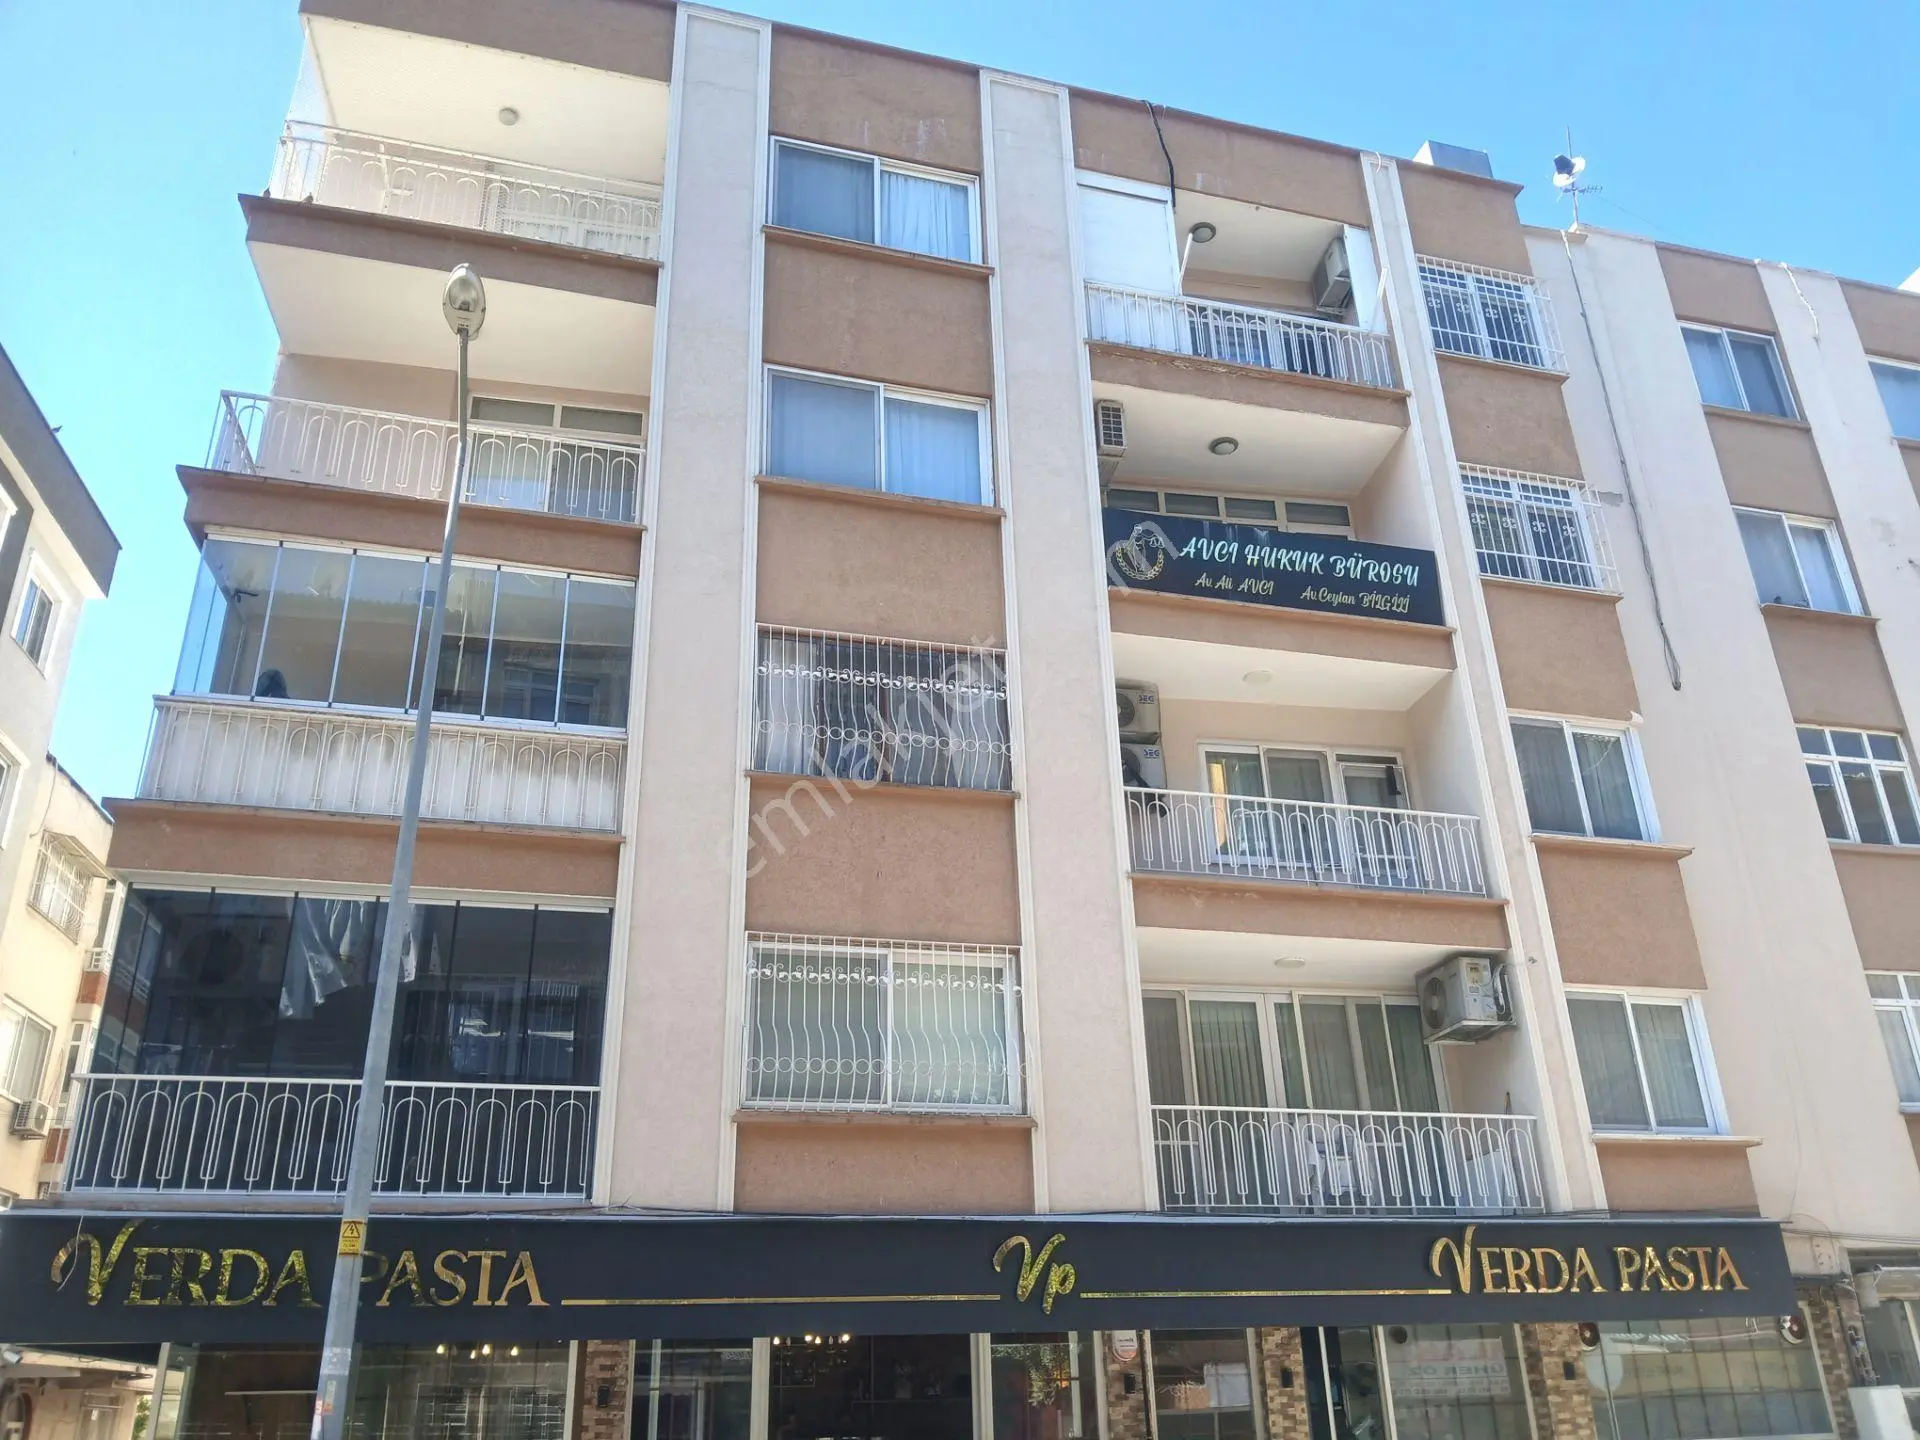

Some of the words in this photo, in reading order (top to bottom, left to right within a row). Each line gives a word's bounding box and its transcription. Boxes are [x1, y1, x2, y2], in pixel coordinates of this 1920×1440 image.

[1179, 537, 1239, 564] AVCI
[1244, 544, 1325, 575] HUKUK
[1329, 552, 1420, 587] BÜROSU
[1214, 574, 1234, 590] Ali
[1237, 578, 1275, 596] AVCI
[51, 1217, 323, 1307] VERDA
[1430, 1223, 1609, 1294] VERDA
[1613, 1246, 1749, 1292] PASTA
